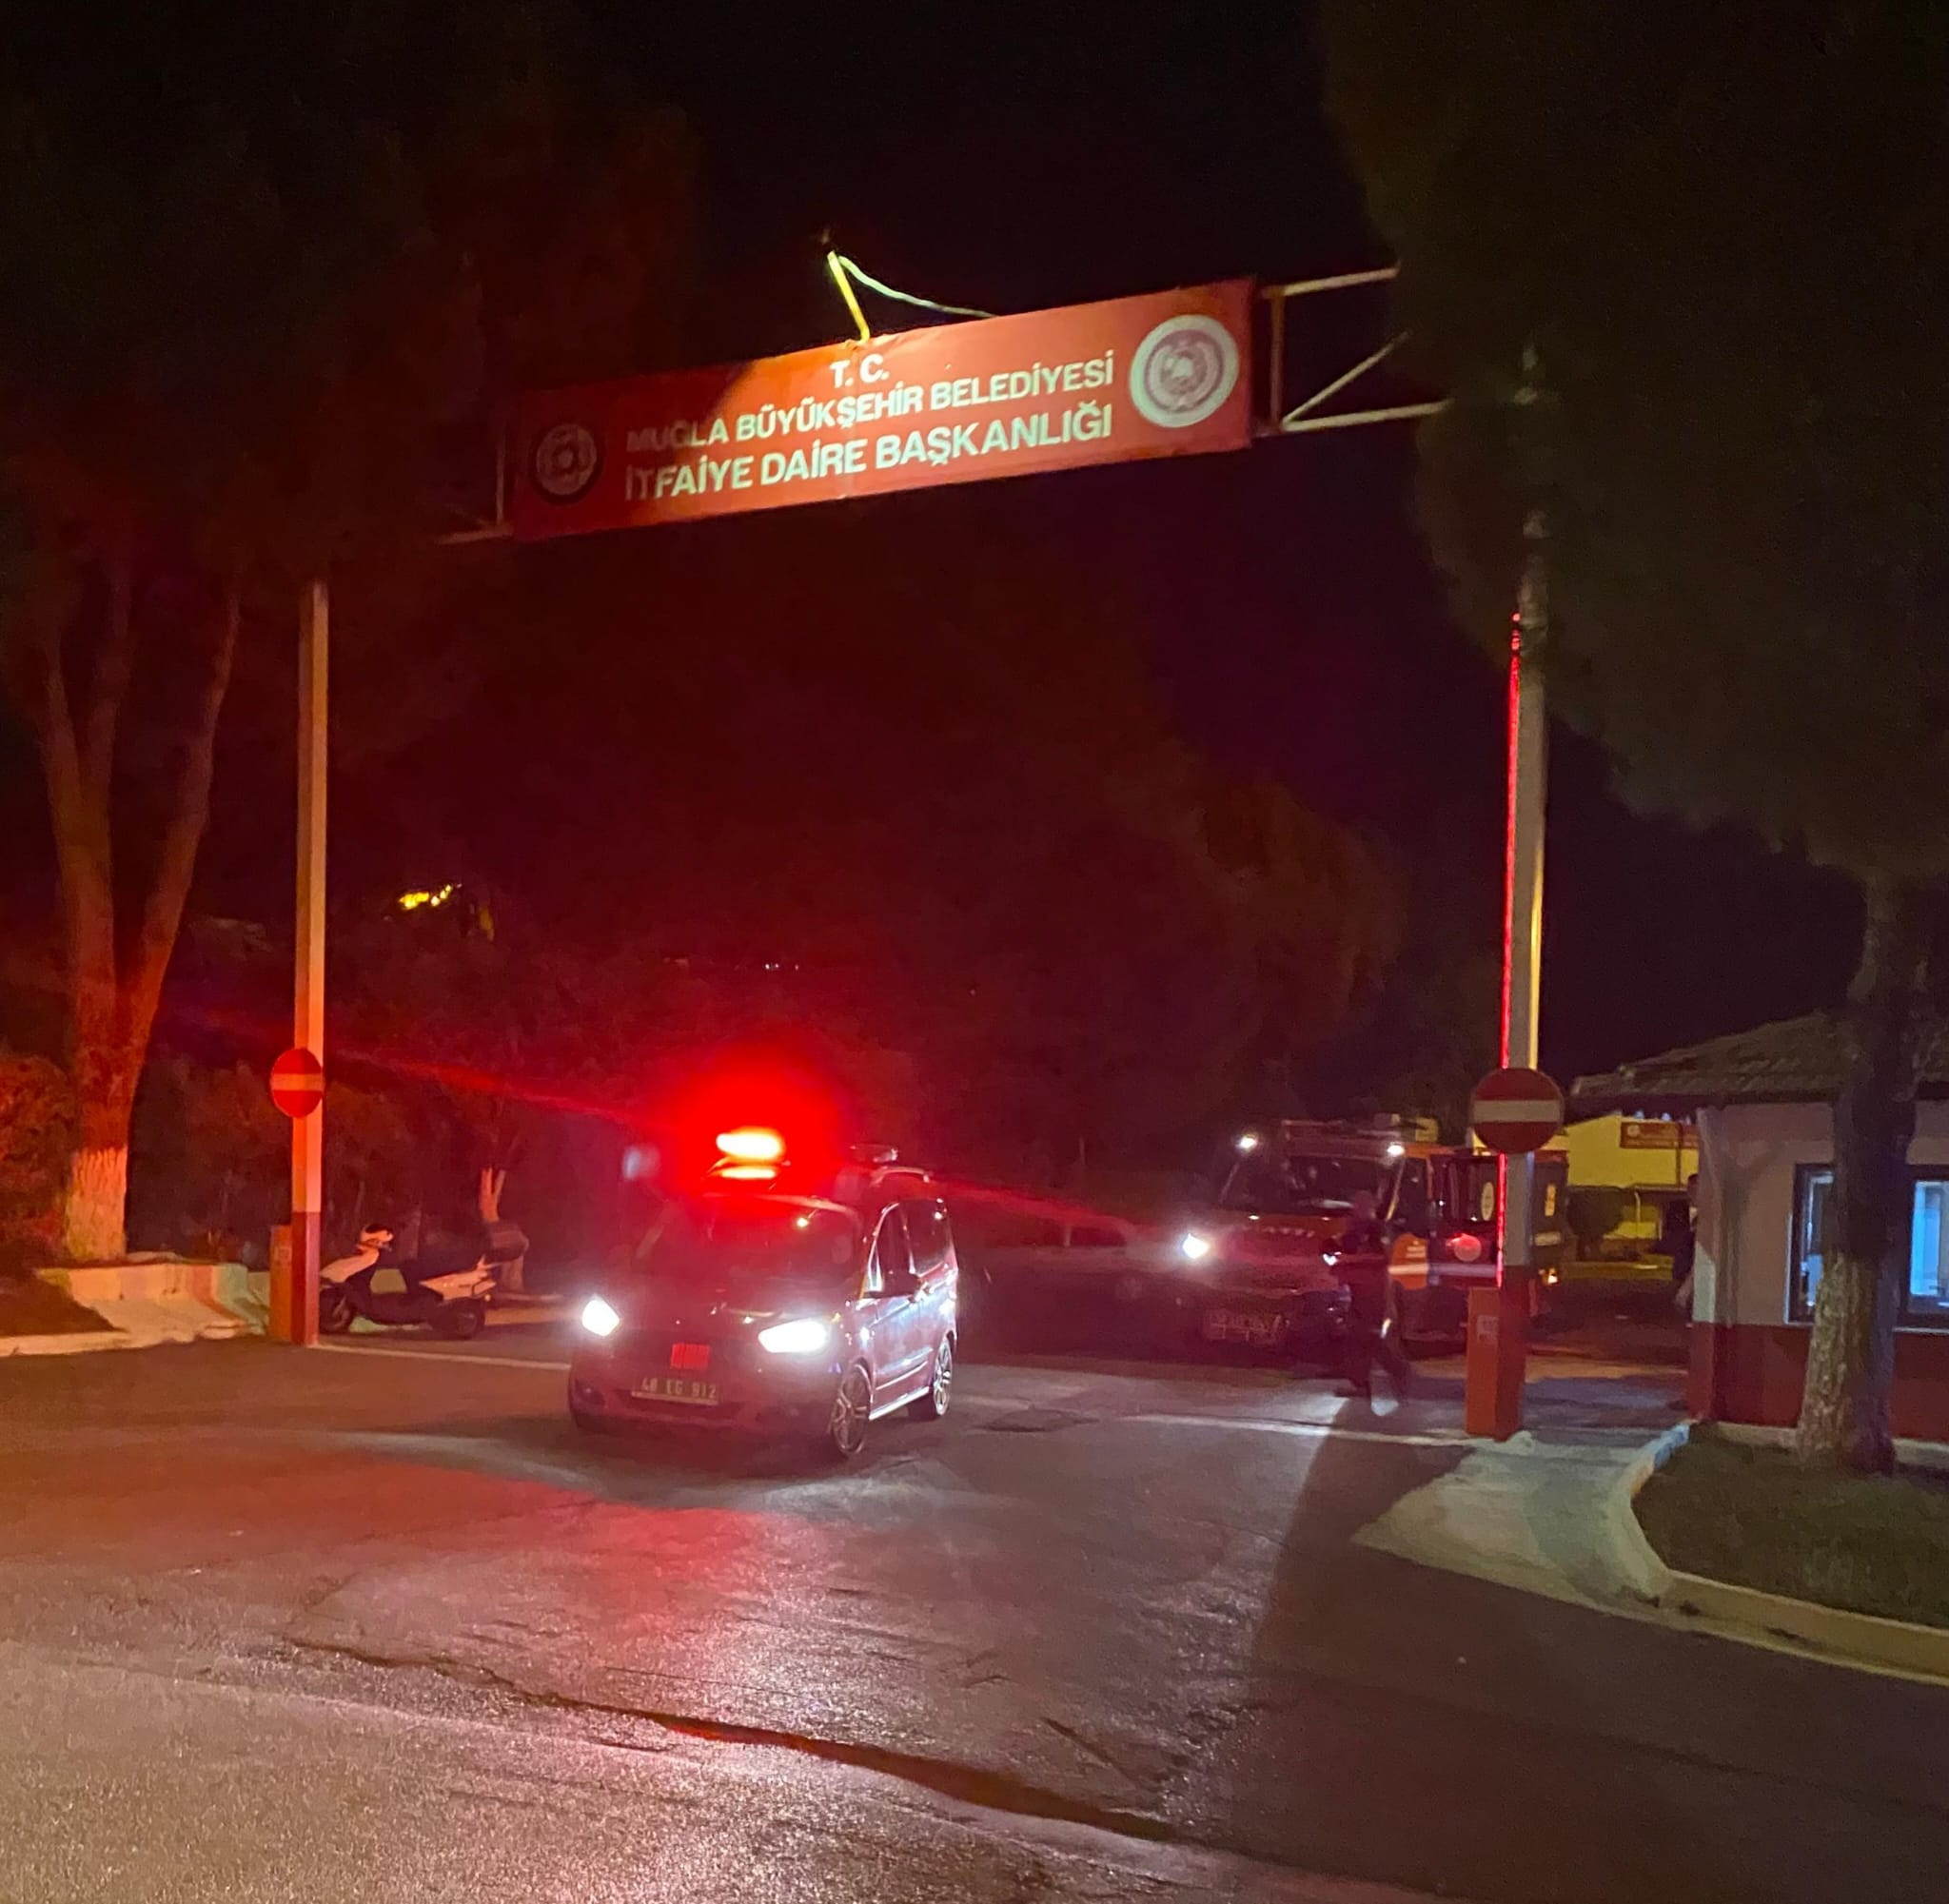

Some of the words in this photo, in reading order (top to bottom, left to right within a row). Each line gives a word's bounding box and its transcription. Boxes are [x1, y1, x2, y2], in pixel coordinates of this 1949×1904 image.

[736, 381, 923, 442] BÜYÜKŞEHİR
[930, 349, 1114, 411] BELEDİYESİ
[625, 455, 754, 501] İTFAİYE
[761, 439, 868, 486] DAİRE
[876, 400, 1112, 469] BAŞKANLIĞI
